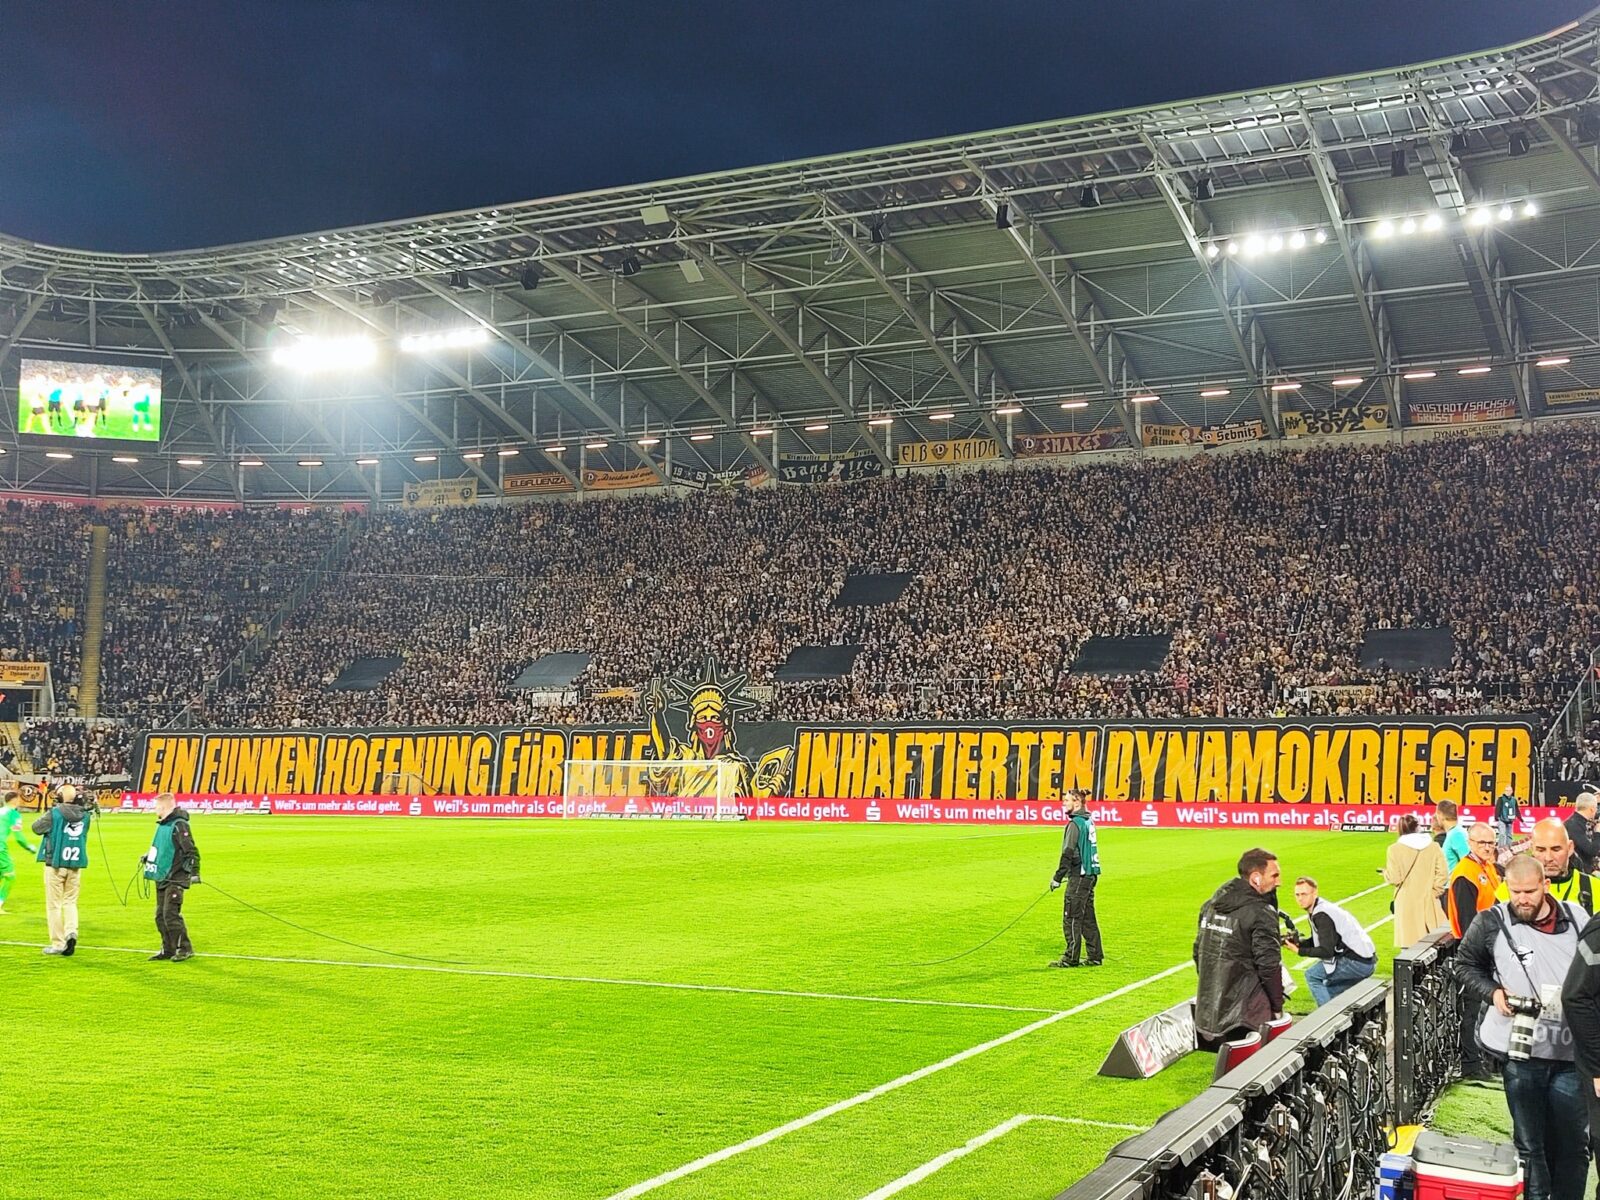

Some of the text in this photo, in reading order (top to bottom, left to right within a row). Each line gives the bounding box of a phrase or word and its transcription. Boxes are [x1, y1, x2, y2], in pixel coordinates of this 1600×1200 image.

[1408, 397, 1516, 413] NEUSTADT/SACHSEN
[1299, 405, 1372, 424] FREAK
[1462, 411, 1479, 422] DIE
[1144, 424, 1176, 437] Crime
[1306, 419, 1367, 434] BOYZ
[1434, 428, 1469, 440] DYNAMO
[1216, 427, 1257, 442] Sebnitz
[901, 443, 928, 463] ELB
[952, 438, 997, 461] KAIDA
[672, 465, 708, 481] 19 53
[142, 736, 200, 796] EIN
[198, 735, 320, 796] FUNKEN
[322, 734, 495, 797] HOFFNUNG
[502, 728, 564, 797] FÜR
[568, 731, 651, 797] ALLE
[794, 730, 1098, 802] INHAFTIERTEN
[1103, 728, 1533, 807] DYNAMOKRIEGER
[137, 799, 157, 809] Weil
[212, 800, 232, 809] Geld
[275, 800, 301, 809] Weil's
[318, 801, 341, 810] mehr
[342, 801, 356, 810] als
[356, 801, 377, 811] Geld
[378, 801, 402, 813] geht.
[433, 799, 469, 813] Weil's
[471, 803, 491, 813] um
[493, 800, 525, 814] mehr
[527, 800, 545, 814] als
[547, 801, 575, 814] Ged
[651, 801, 850, 821] Weil's um mehr als Geld geht.
[896, 803, 942, 819] Weil's
[945, 807, 969, 819] um
[972, 805, 1014, 820] mehr
[1016, 805, 1038, 820] als
[1091, 806, 1122, 822] eht.
[1176, 808, 1228, 824] Weil's
[1231, 811, 1259, 825] um
[1263, 809, 1311, 825] mehr
[1314, 810, 1340, 825] als
[1343, 810, 1385, 824] Geld
[62, 846, 80, 861] 02
[1535, 1026, 1574, 1046] OTO
